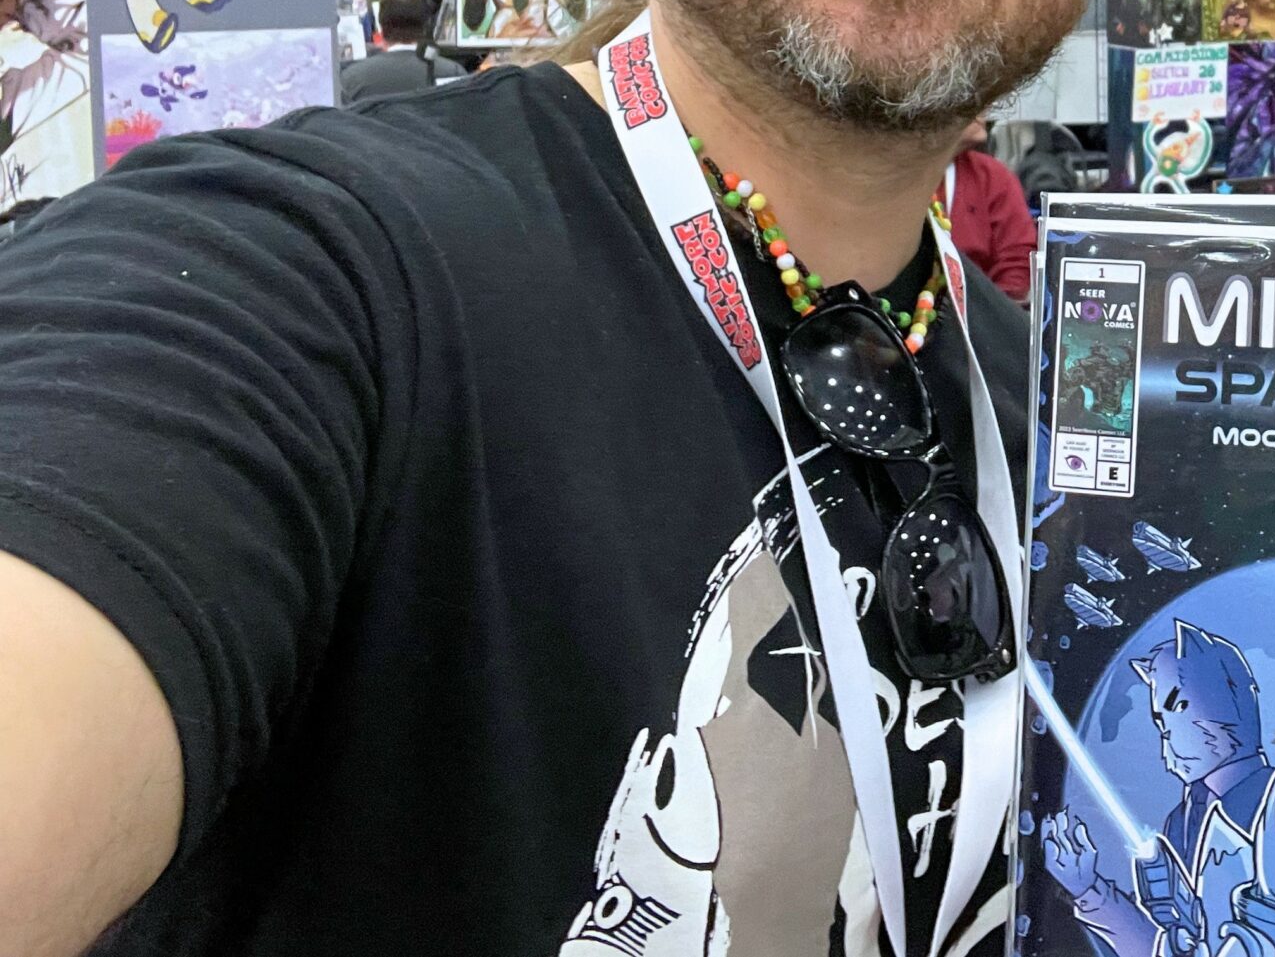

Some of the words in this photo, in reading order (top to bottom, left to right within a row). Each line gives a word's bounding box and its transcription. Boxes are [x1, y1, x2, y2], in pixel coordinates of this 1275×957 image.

[1098, 267, 1105, 278] 1
[1079, 288, 1106, 298] SEER
[1103, 321, 1135, 329] COMICS
[1108, 466, 1119, 481] E
